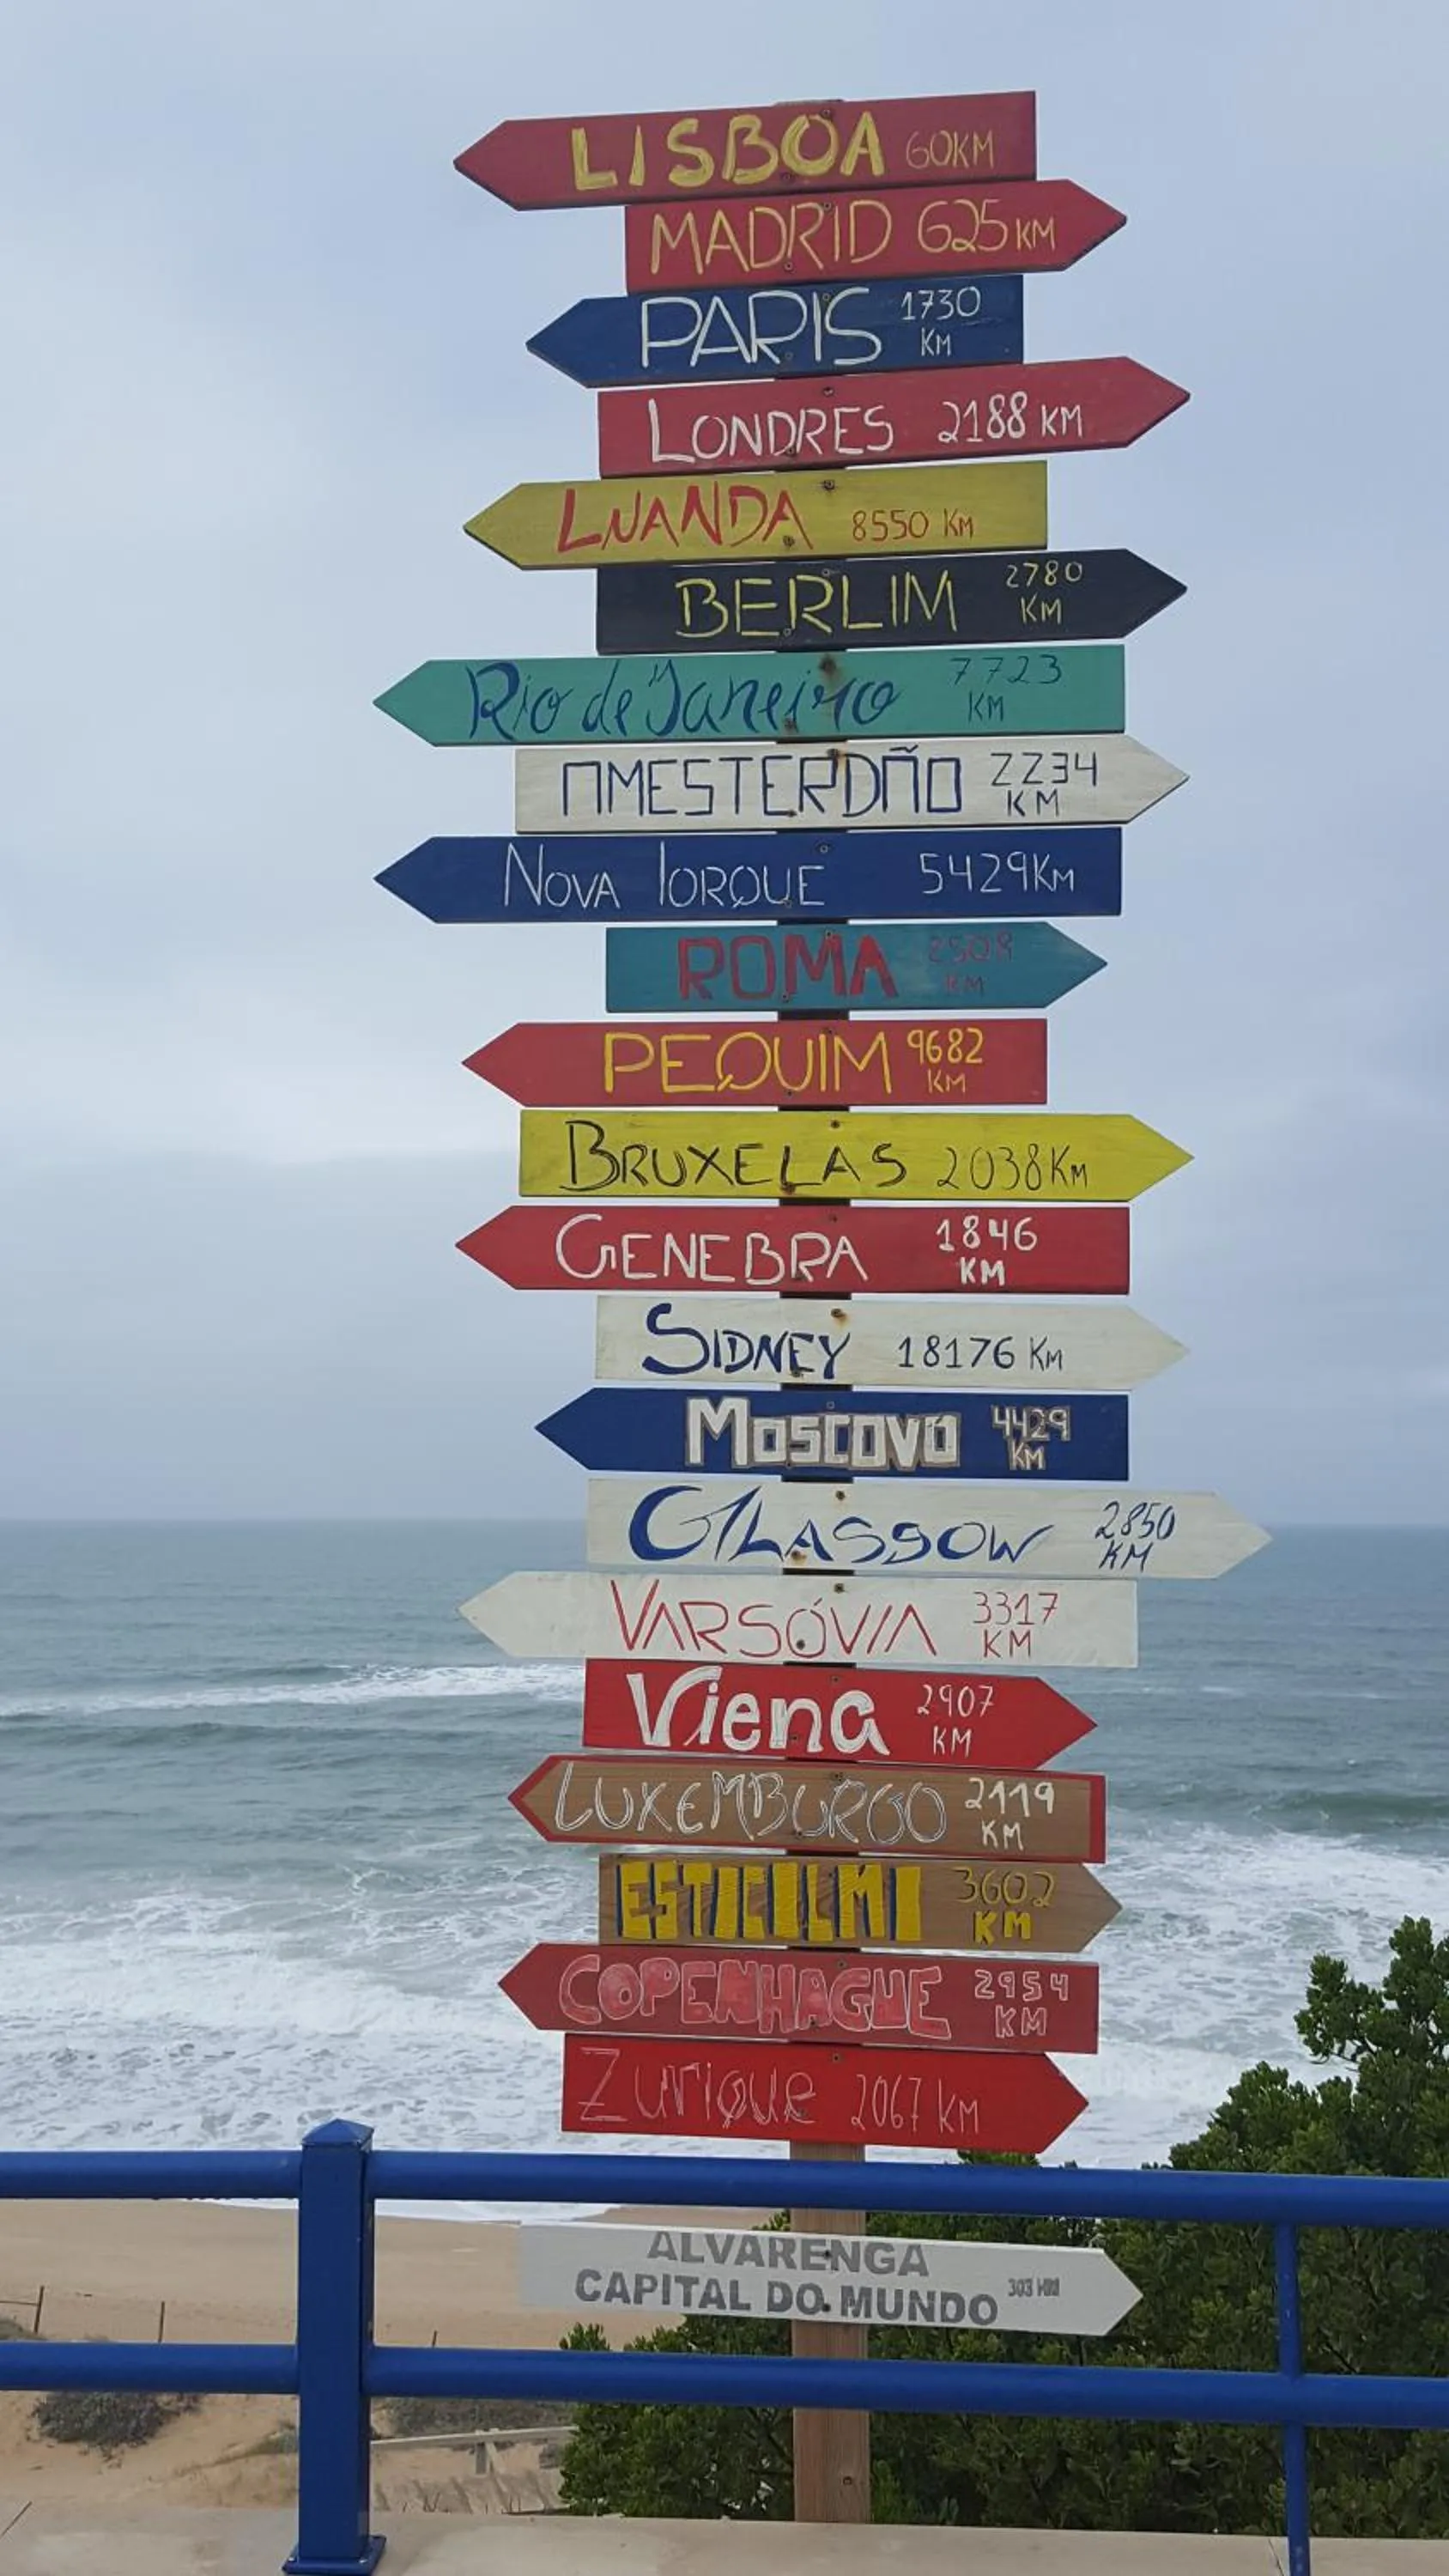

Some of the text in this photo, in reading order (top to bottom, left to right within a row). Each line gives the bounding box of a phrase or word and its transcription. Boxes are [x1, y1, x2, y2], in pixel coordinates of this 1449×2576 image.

[572, 112, 885, 190] LISBOA
[905, 130, 994, 170] 60KM
[651, 202, 893, 275] MADRID
[918, 201, 1057, 253] 625 KM
[900, 286, 981, 319] 1730
[641, 288, 882, 368] PARIS
[649, 398, 894, 463] LONDRES
[937, 391, 1083, 443] 2188 KM
[852, 509, 929, 540] 8550
[1005, 562, 1082, 588] 2780
[676, 571, 957, 639] BERLIM
[1021, 596, 1062, 625] KM
[950, 656, 1062, 686] 7723
[466, 659, 901, 740] Rio de Janeiro
[968, 692, 1005, 722] KM
[1007, 789, 1059, 817] KM
[504, 843, 620, 908] NOVA
[677, 934, 899, 1001] ROMA
[605, 1032, 892, 1095] PEQUIM
[907, 1027, 984, 1067] 9682
[927, 1069, 967, 1093] KM
[560, 1120, 906, 1191] BRUXELAS
[556, 1214, 868, 1285] GENEBRA
[936, 1218, 1037, 1252] 1846
[961, 1257, 1005, 1285] KM
[641, 1303, 851, 1376] SIDNEY
[898, 1336, 1016, 1370] 18176
[991, 1405, 1070, 1441] 4429
[1093, 1500, 1176, 1540] 2850
[1099, 1541, 1151, 1571] KM
[610, 1579, 935, 1660] VARSÓVIA
[973, 1592, 1058, 1625] 3317
[984, 1631, 1032, 1657] KM
[627, 1665, 891, 1756] Viena
[919, 1685, 995, 1717] 2907
[932, 1728, 971, 1757] KM
[965, 1777, 1053, 1815] 2119
[982, 1820, 1024, 1850] KM
[959, 1868, 1056, 1909] 3602
[976, 1911, 1032, 1942] KM
[559, 1953, 951, 2039] COPENHAGUE
[975, 1970, 1069, 2002] 2954
[997, 2006, 1046, 2037] KM
[851, 2074, 921, 2133] 2067
[647, 2233, 930, 2277] ALVARENGA
[575, 2269, 750, 2312] CAPITAL
[840, 2286, 998, 2327] MUNDO
